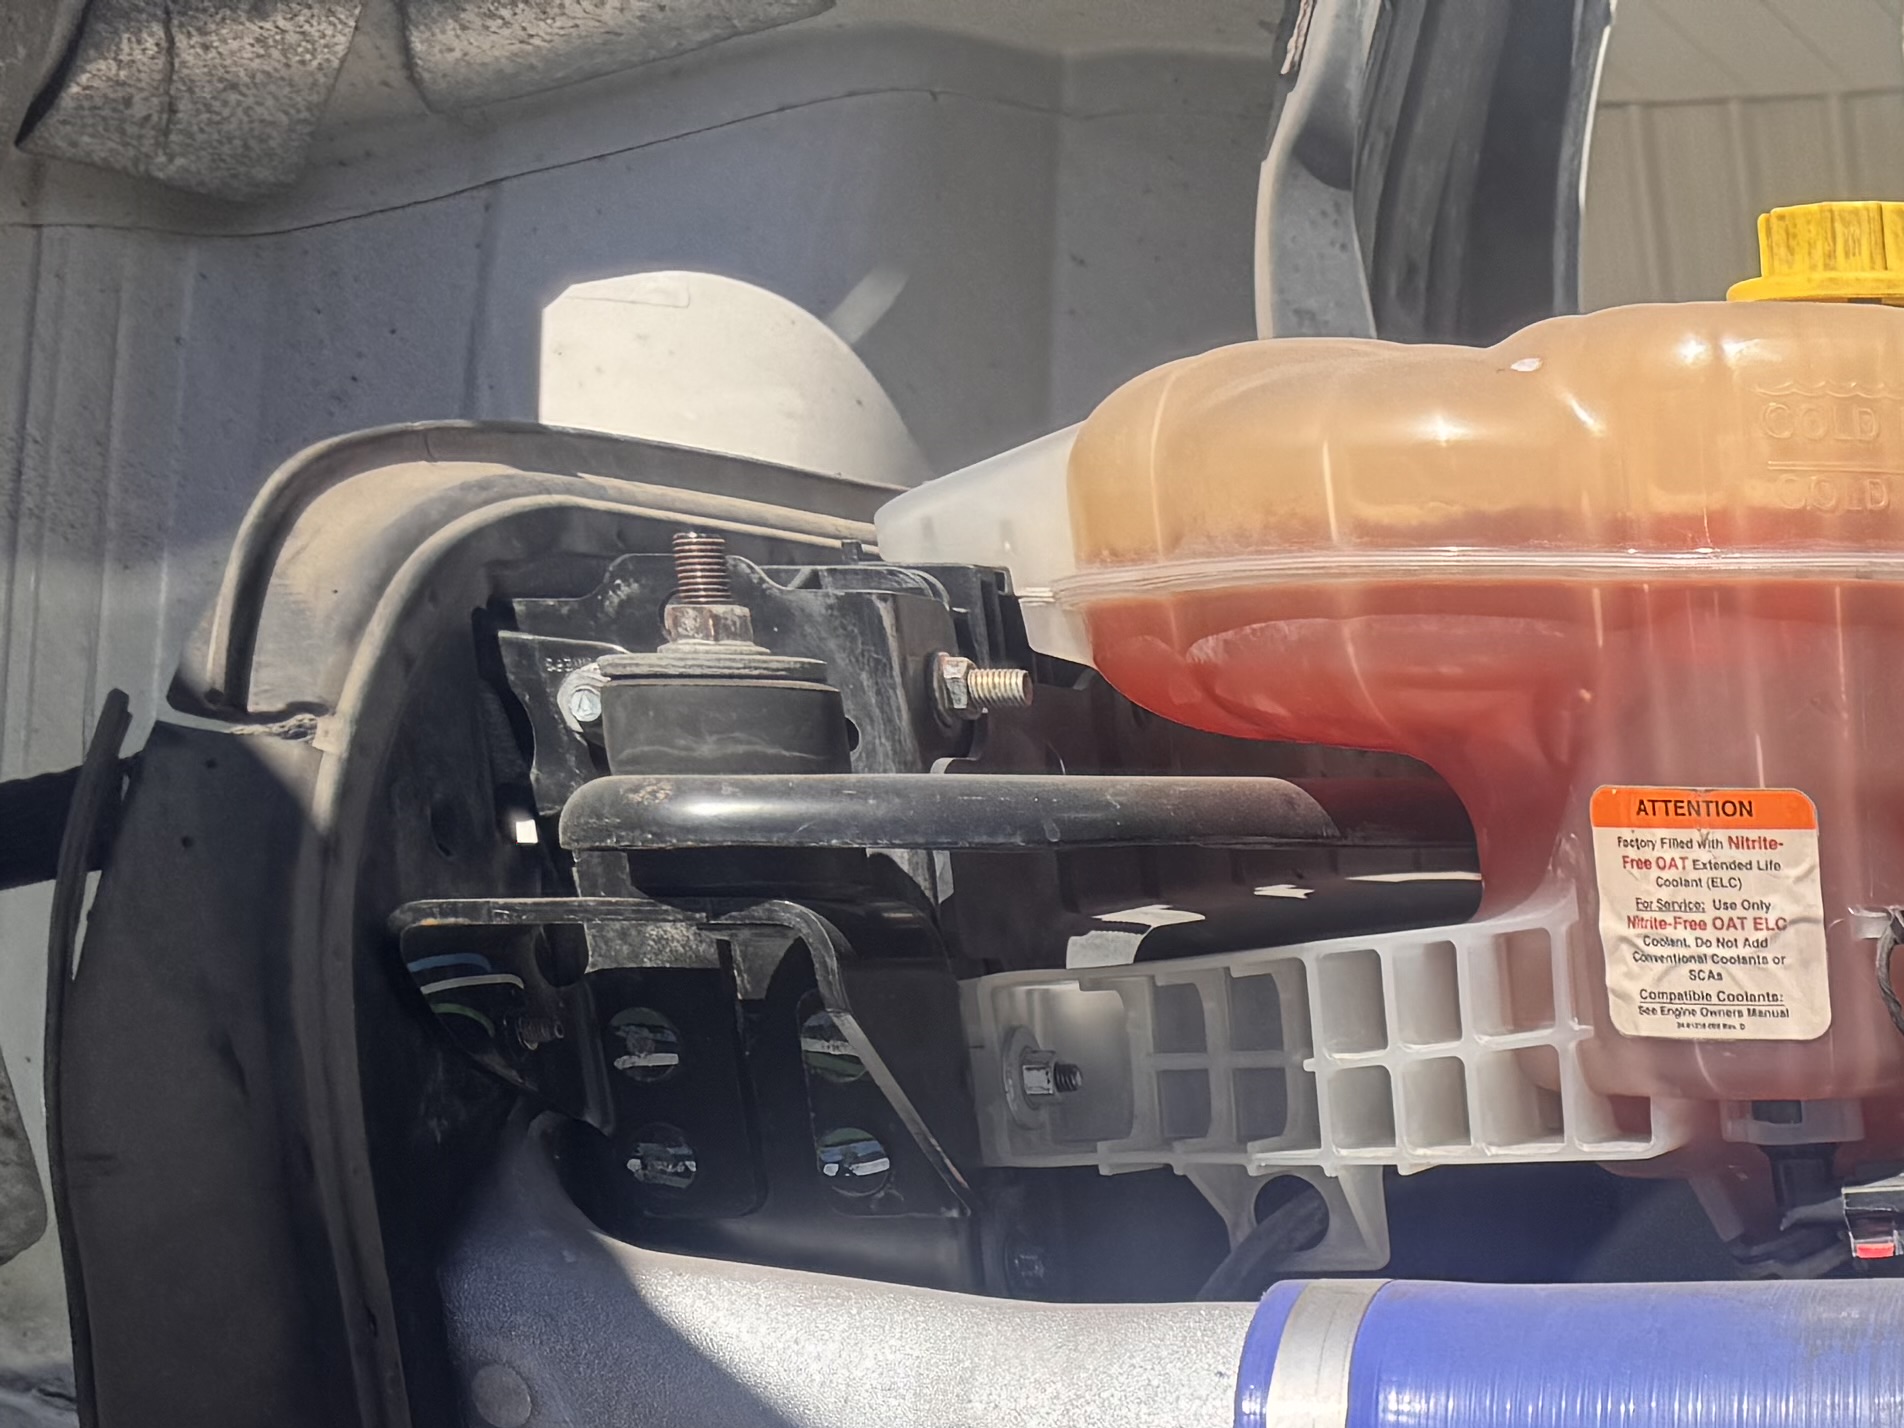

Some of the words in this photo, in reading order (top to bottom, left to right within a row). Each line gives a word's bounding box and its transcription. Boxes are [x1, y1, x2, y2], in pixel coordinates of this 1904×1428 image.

[1761, 403, 1880, 443] COLD
[1777, 474, 1889, 511] COLD
[1636, 799, 1754, 818] ATTENTION
[1617, 836, 1657, 852] Factory
[1696, 838, 1723, 850] with
[1728, 835, 1784, 851] Nitrite-
[1622, 855, 1652, 871] Free
[1655, 856, 1689, 871] OAT
[1692, 858, 1753, 872] Extended
[1656, 876, 1704, 888] Coolant
[1706, 876, 1743, 891] (ELC)
[1635, 898, 1654, 913] For
[1712, 899, 1737, 913] Use
[1740, 899, 1772, 915] Only
[1627, 916, 1707, 932] Nitrite-Free
[1711, 916, 1747, 932] OAT
[1753, 917, 1787, 932] ELC
[1694, 936, 1712, 949] Do
[1716, 936, 1739, 949] Not
[1742, 937, 1769, 949] Add
[1632, 951, 1708, 965] Conventional
[1711, 952, 1769, 965] Coolants
[1772, 954, 1787, 965] or
[1639, 989, 1712, 1004] Compatible
[1660, 1006, 1697, 1019] Engine
[1747, 1007, 1790, 1019] Manual
